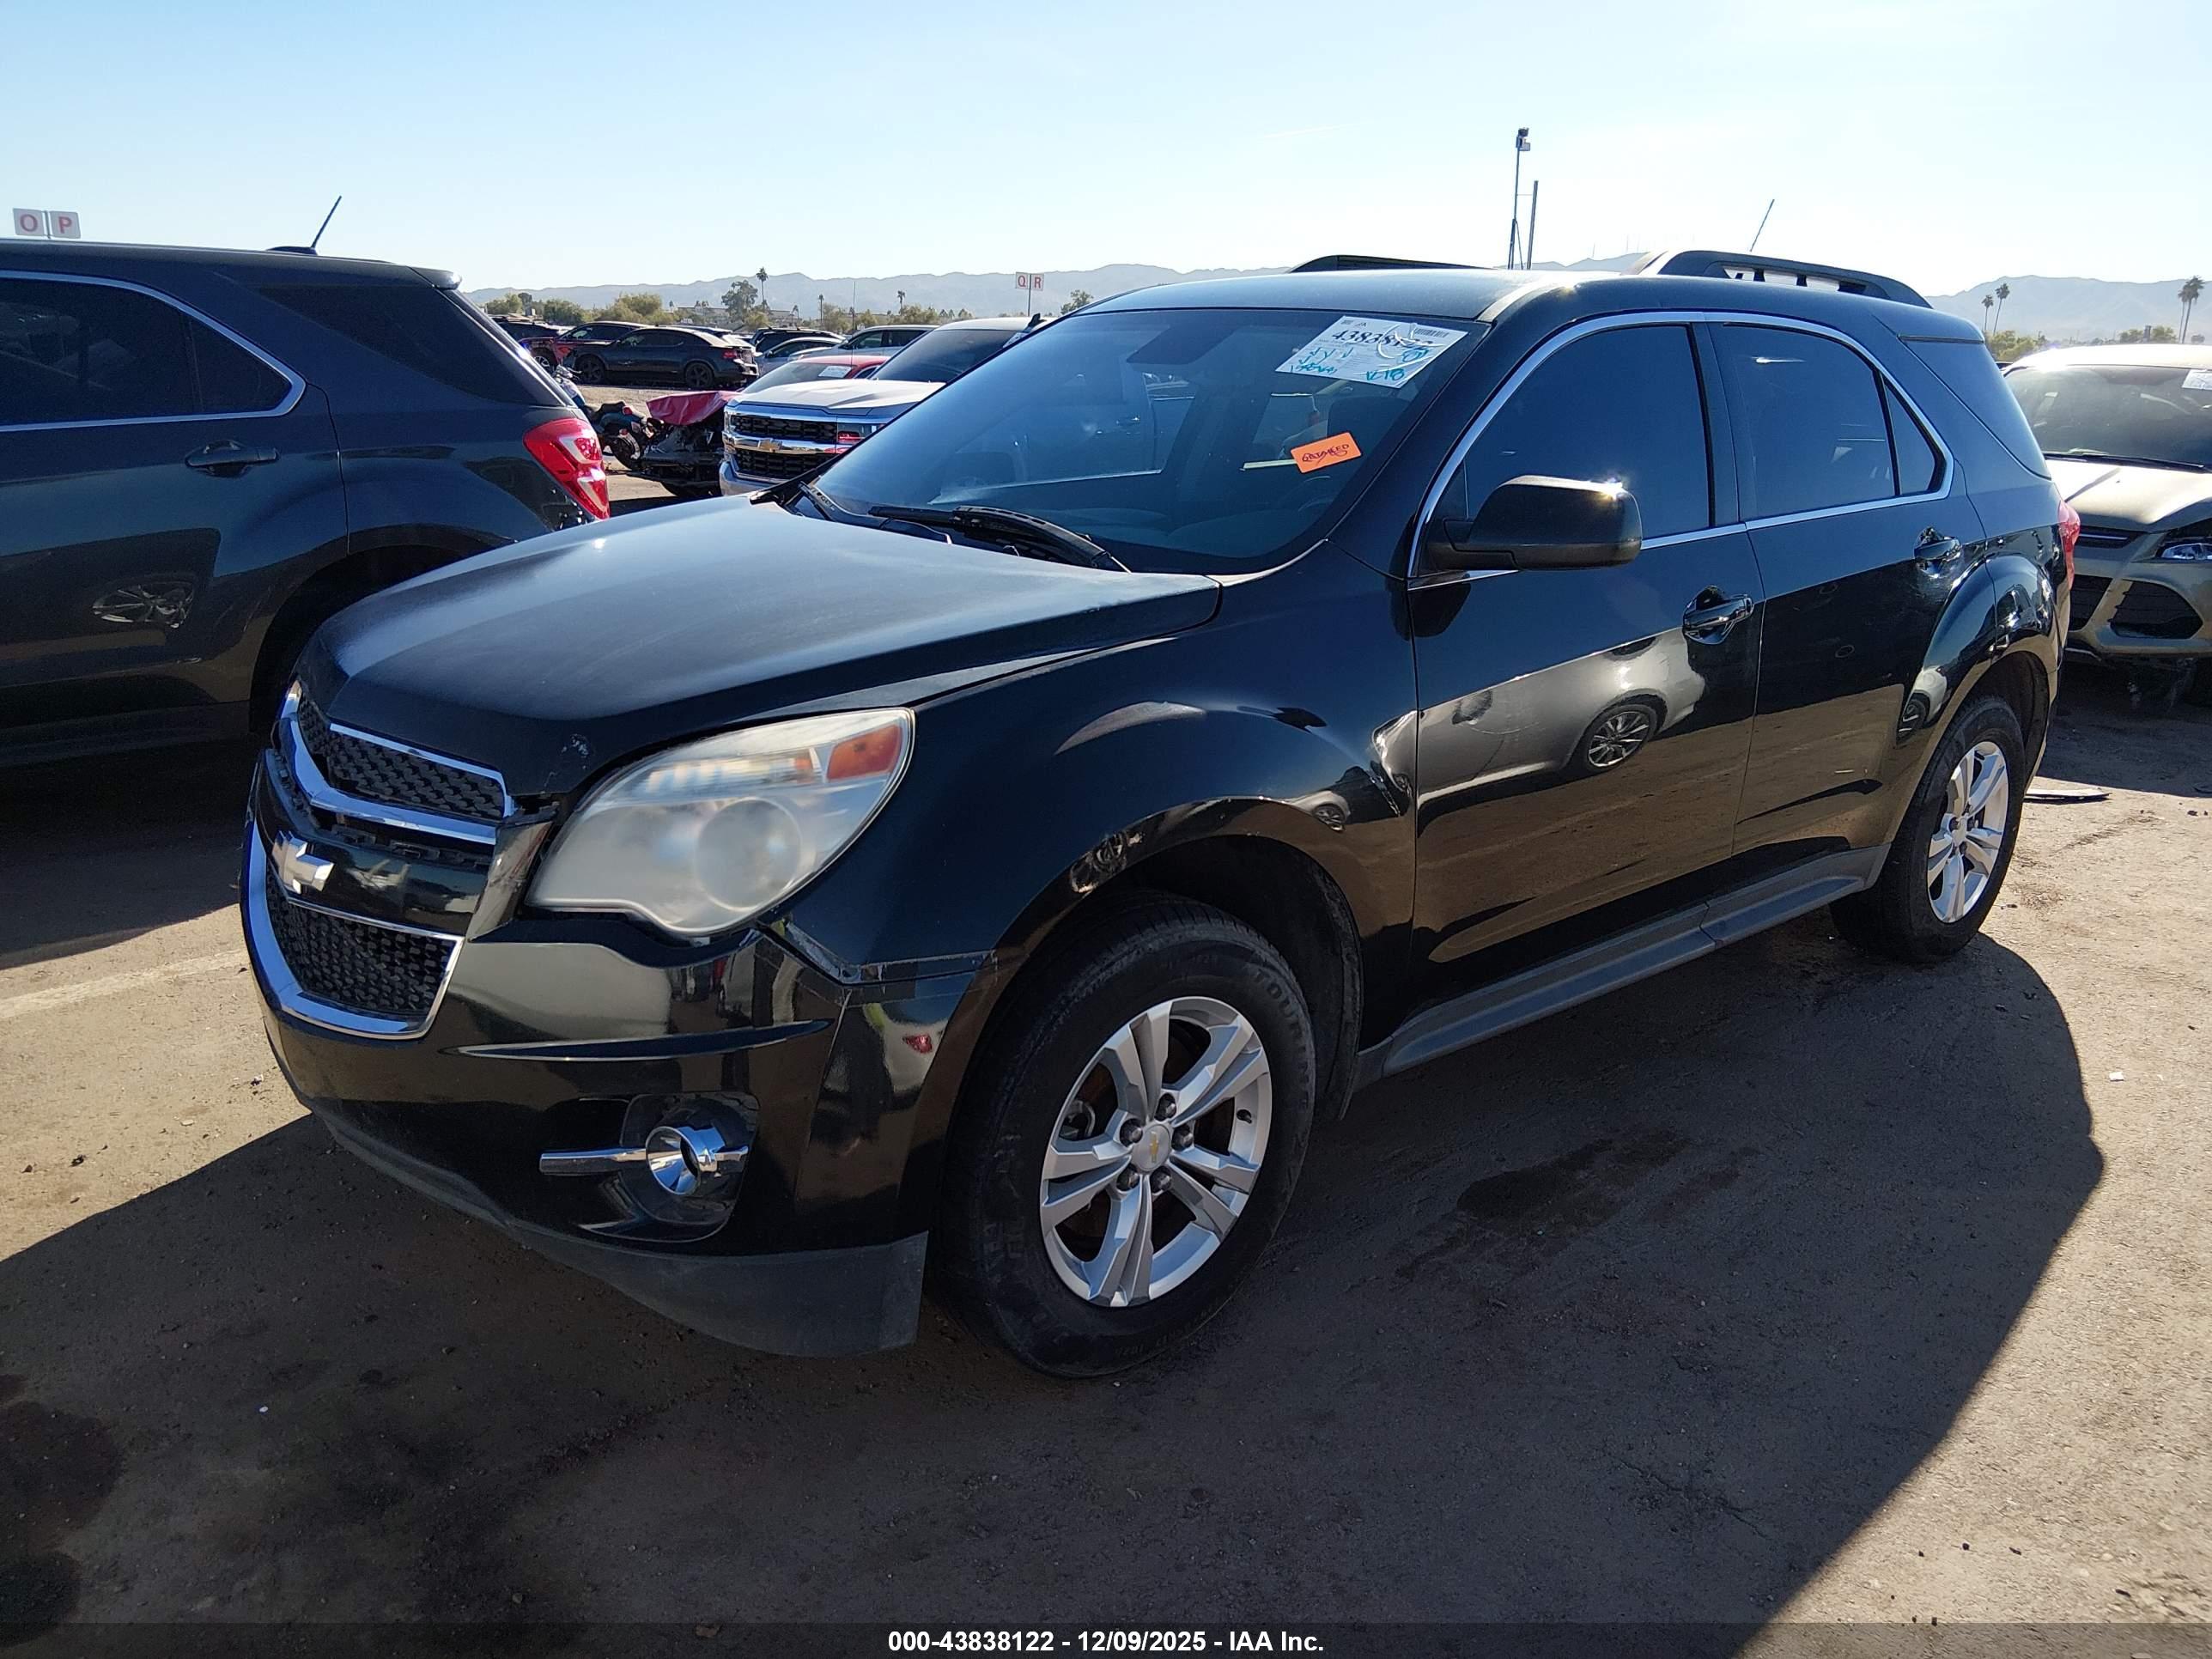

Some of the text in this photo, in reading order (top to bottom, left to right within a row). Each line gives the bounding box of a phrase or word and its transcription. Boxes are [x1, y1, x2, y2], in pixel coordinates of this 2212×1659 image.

[20, 214, 72, 234] O P
[1018, 275, 1042, 289] Q R
